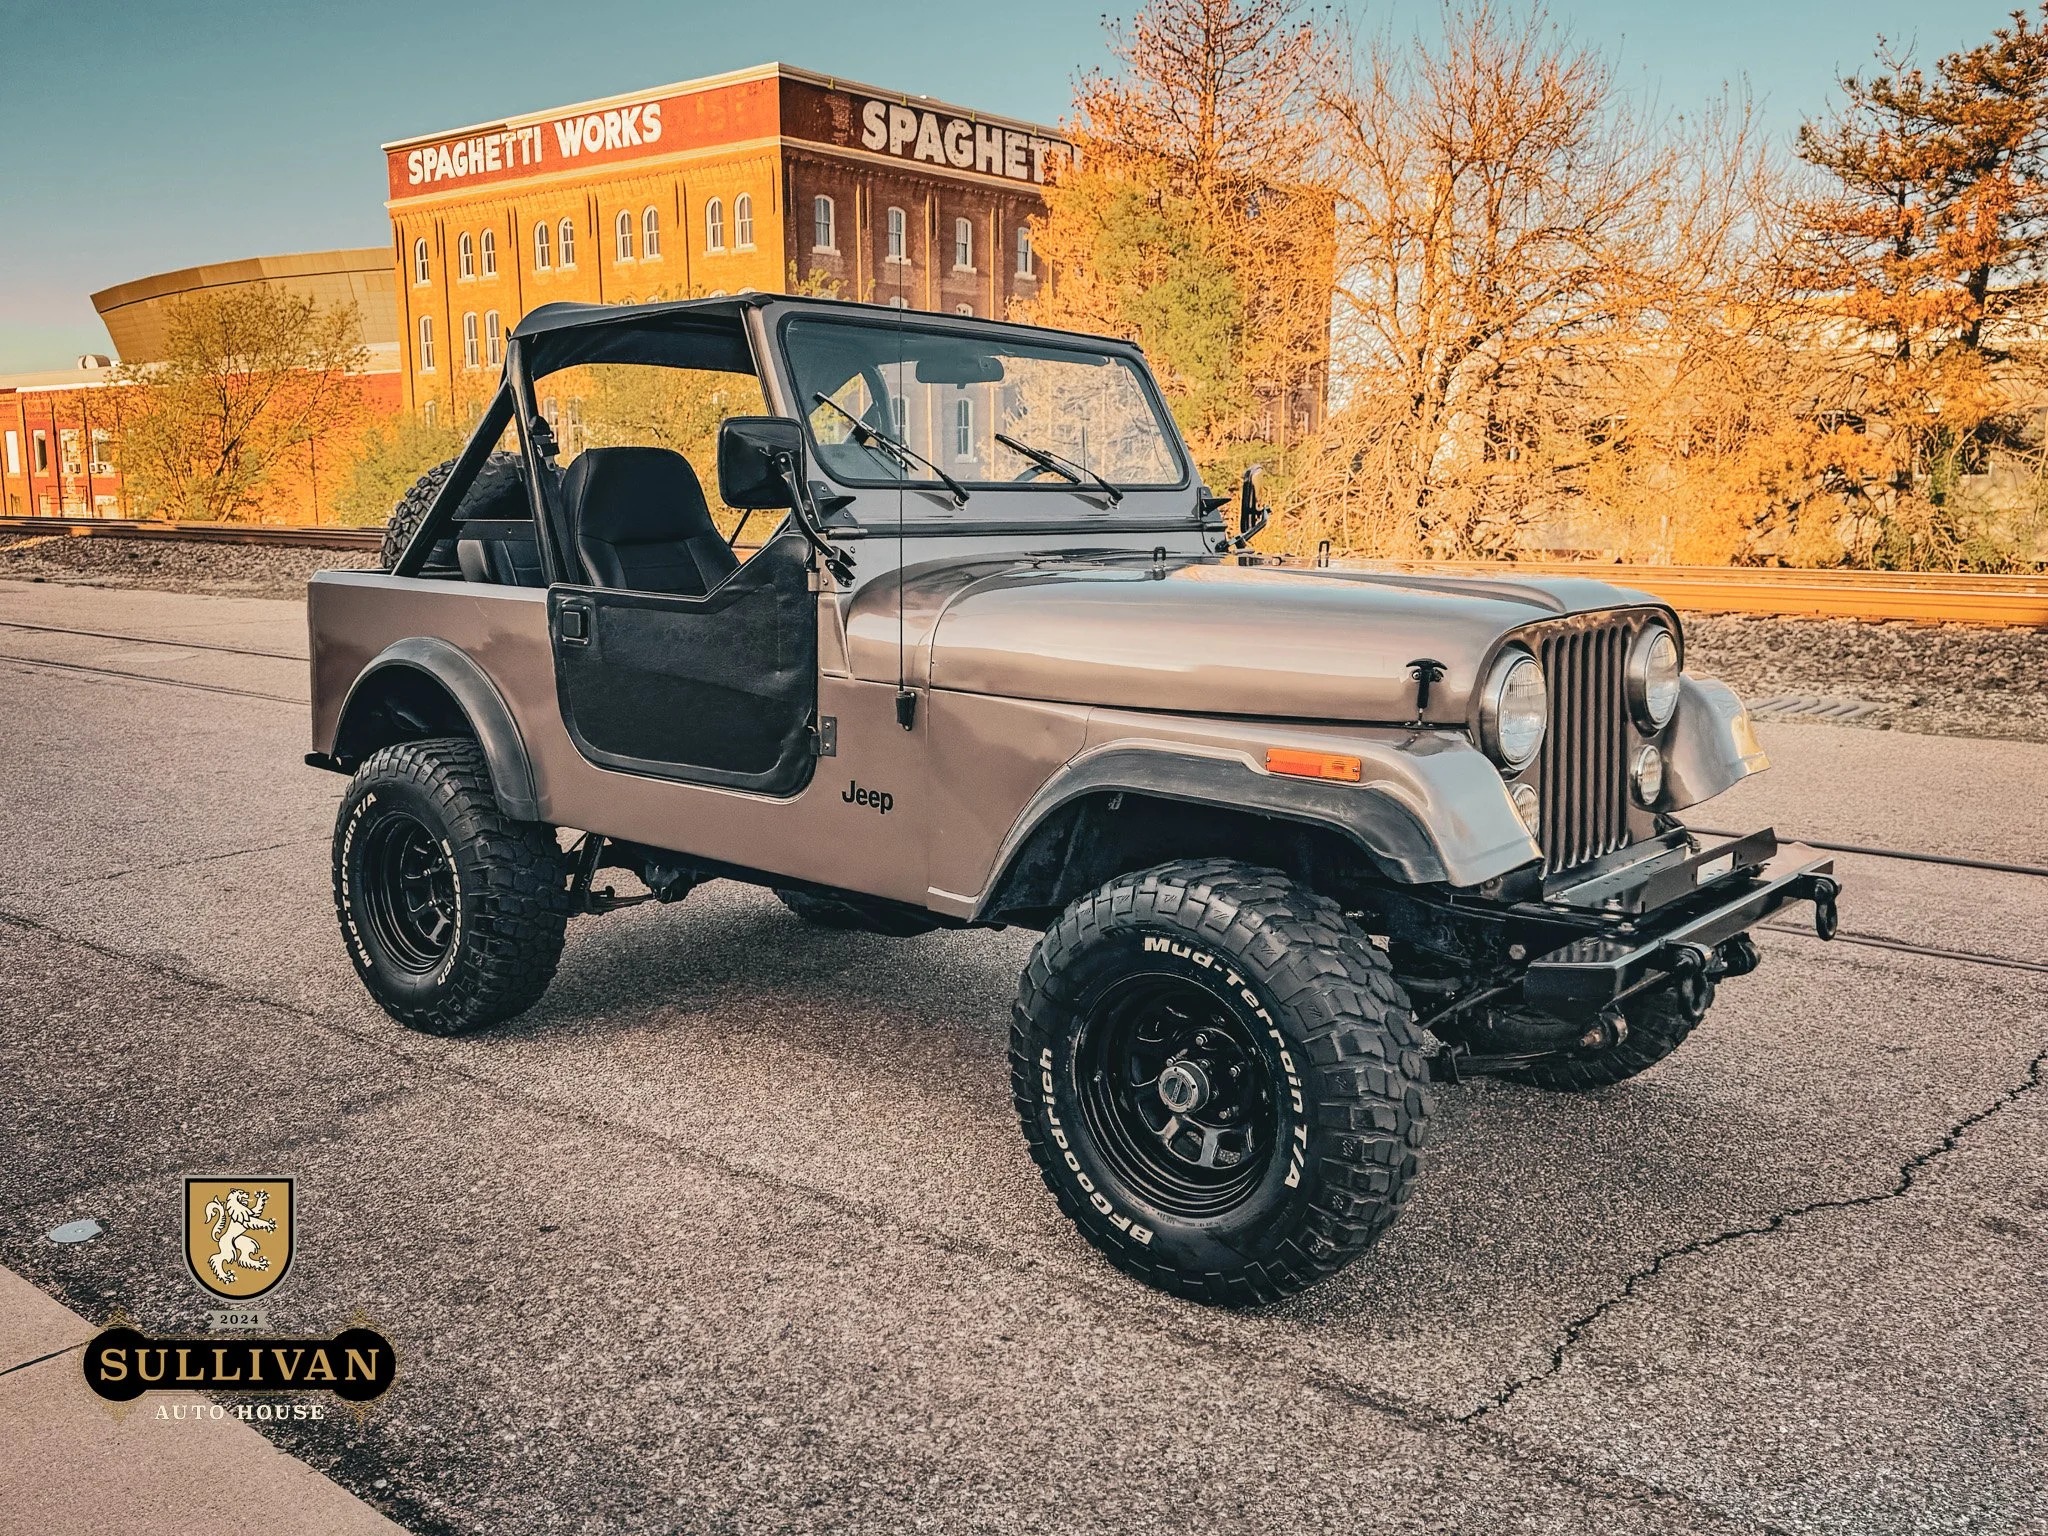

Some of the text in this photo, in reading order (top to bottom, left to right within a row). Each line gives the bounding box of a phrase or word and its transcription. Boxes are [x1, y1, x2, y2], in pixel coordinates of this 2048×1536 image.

[407, 103, 663, 185] SPAGHETTI WORKS
[353, 792, 377, 819] T/A
[842, 780, 894, 814] Jeep
[1144, 936, 1304, 1114] Mud-Terrain
[1284, 1123, 1307, 1189] T/A
[1039, 1047, 1154, 1245] BFGoodrich
